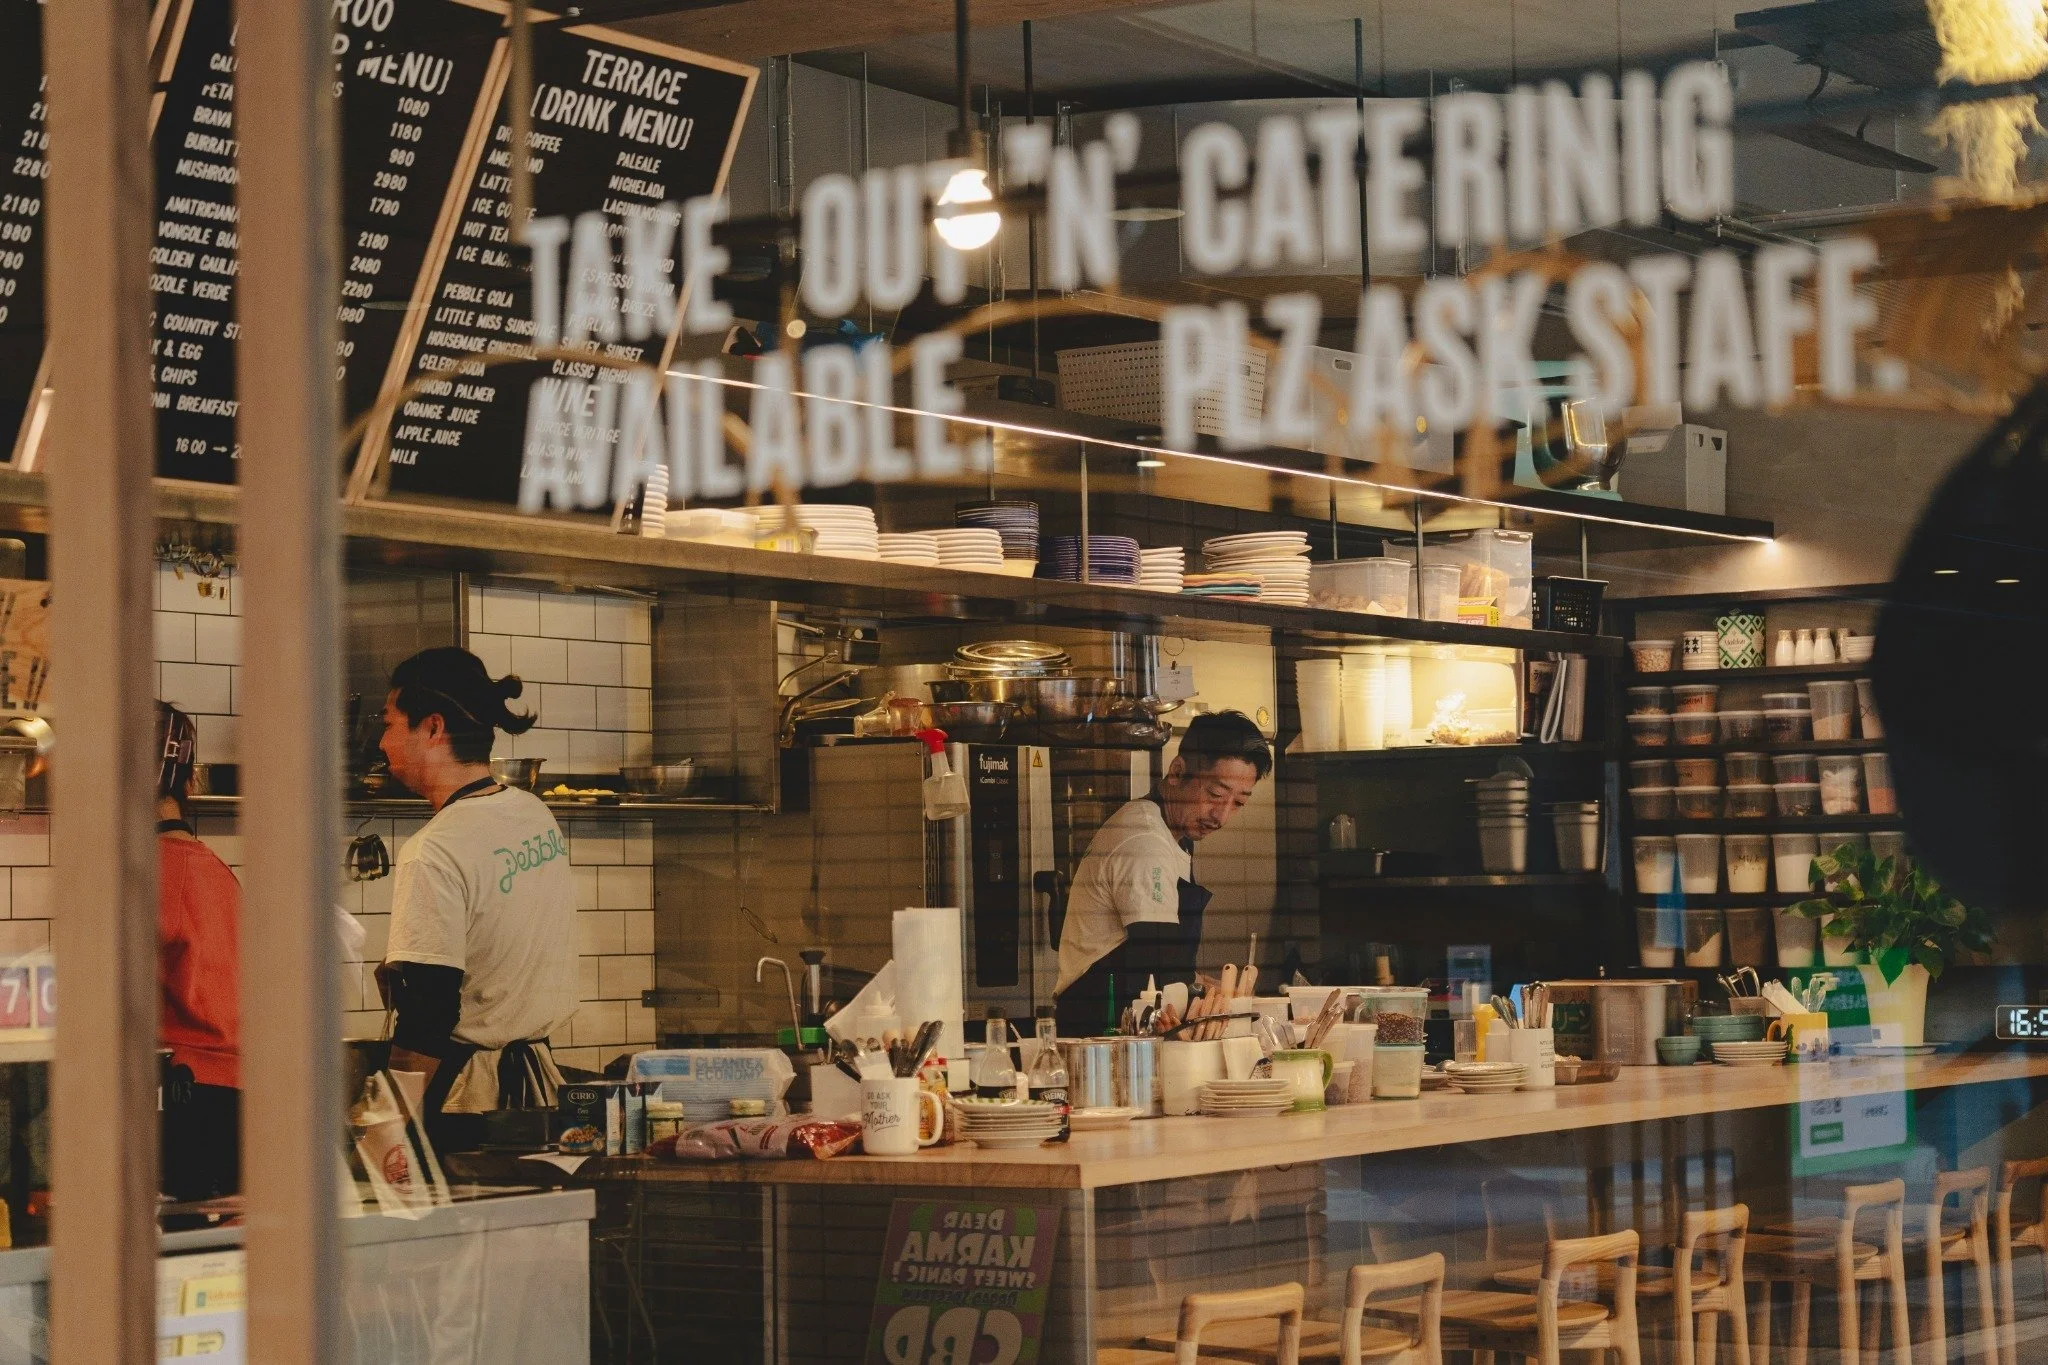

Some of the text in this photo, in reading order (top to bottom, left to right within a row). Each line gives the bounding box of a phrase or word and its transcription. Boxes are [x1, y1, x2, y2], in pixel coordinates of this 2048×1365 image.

[581, 49, 688, 105] TERRACE
[397, 96, 431, 118] 1080
[529, 83, 694, 151] (DRINK MENU)
[390, 121, 423, 142] 1180
[525, 131, 563, 153] COFFEE
[388, 148, 415, 167] 980
[175, 158, 238, 185] MUSHROO
[373, 171, 408, 192] 2980
[608, 174, 666, 200] MICHELADA
[1, 193, 41, 217] 2180
[369, 197, 400, 216] 1780
[471, 198, 495, 218] ICE
[523, 195, 735, 347] TAKE
[802, 160, 970, 318] OUT
[1180, 60, 1735, 275] CATERINIG
[0, 221, 32, 243] 980
[158, 220, 213, 245] VONGOLE
[358, 231, 389, 251] 2180
[462, 220, 511, 243] HOT TEA
[350, 255, 382, 275] 2480
[455, 245, 479, 263] ICE
[192, 280, 232, 302] VERDE
[341, 280, 374, 299] 2280
[442, 282, 514, 309] PEBBLE COLA
[163, 313, 219, 337] COUNTRY
[434, 306, 476, 328] LITTLE
[476, 312, 502, 332] MISS
[163, 339, 174, 358] &
[178, 341, 204, 361] EGG
[426, 330, 488, 354] HOUSEMADE
[418, 353, 486, 377] CELERY SODA
[603, 344, 645, 364] SUNSET
[161, 366, 198, 386] CHIPS
[517, 236, 1910, 514] AVAILABLE. PLZ ASK STAFF.
[552, 358, 596, 380] CLASSIC
[454, 383, 496, 403] PALMER
[176, 394, 240, 418] BREAKFAST
[403, 400, 481, 425] ORANGE JUICE
[395, 424, 462, 447] APPLE JUICE
[389, 448, 419, 466] MILK
[979, 753, 1009, 773] fujimak
[695, 1068, 763, 1081] ECONOMY
[570, 1092, 596, 1100] CIRIO
[1044, 1091, 1066, 1101] HEINZ
